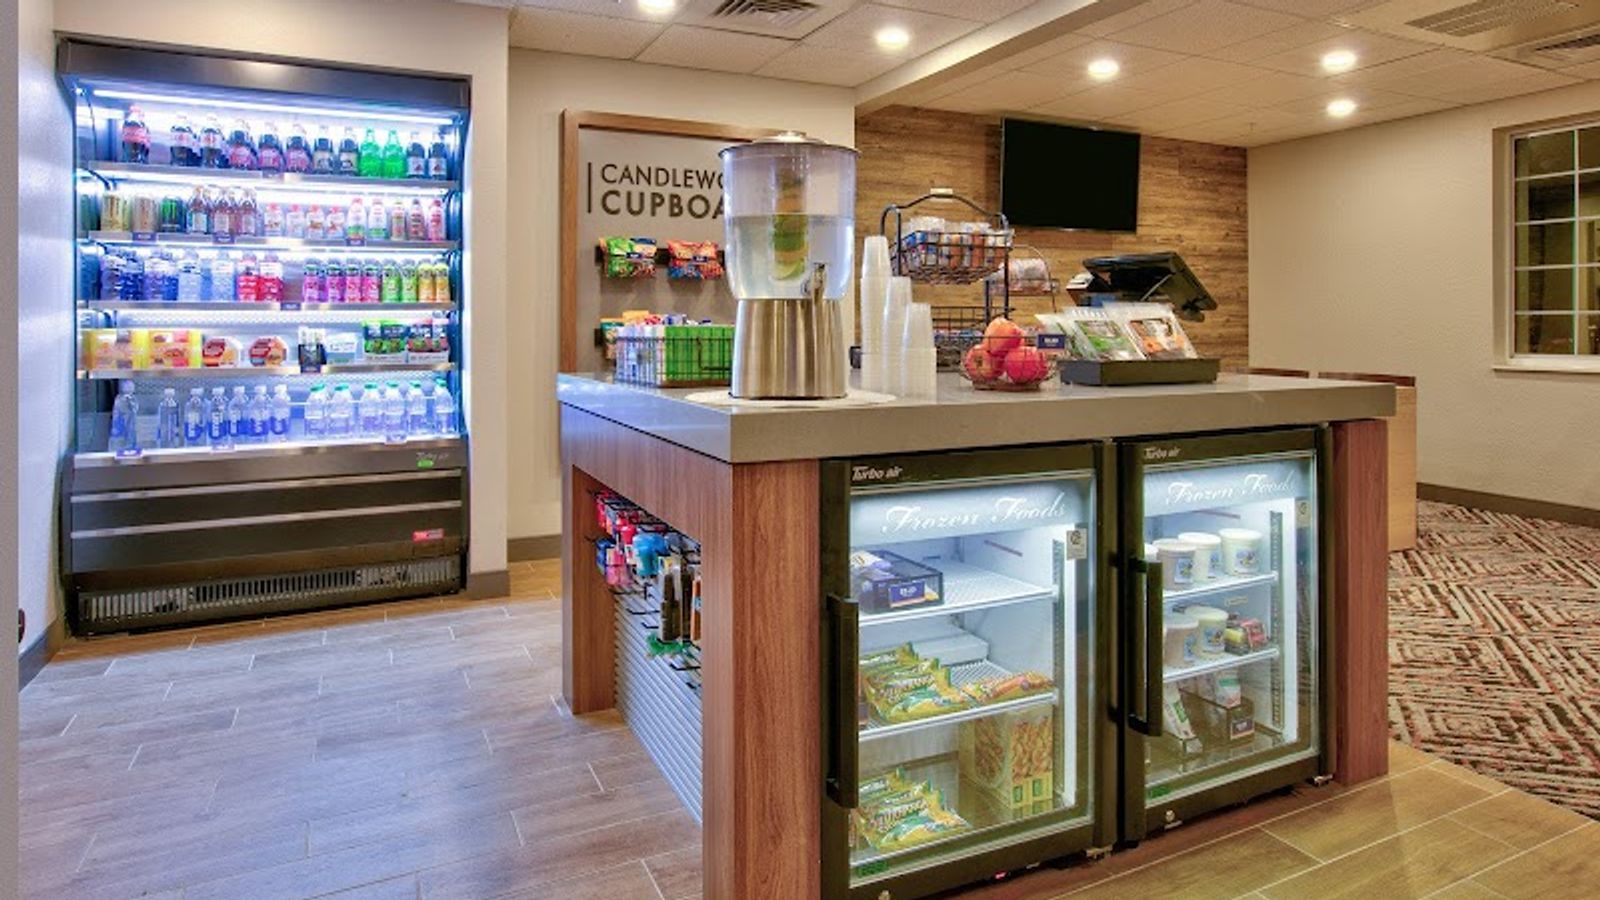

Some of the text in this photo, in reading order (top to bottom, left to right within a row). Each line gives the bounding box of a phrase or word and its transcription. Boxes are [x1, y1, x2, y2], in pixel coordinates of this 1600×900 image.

[601, 163, 724, 190] CANDLEW
[852, 465, 903, 481] Turbo air
[1165, 481, 1234, 505] Frozen
[882, 492, 1066, 534] Frozen Foods
